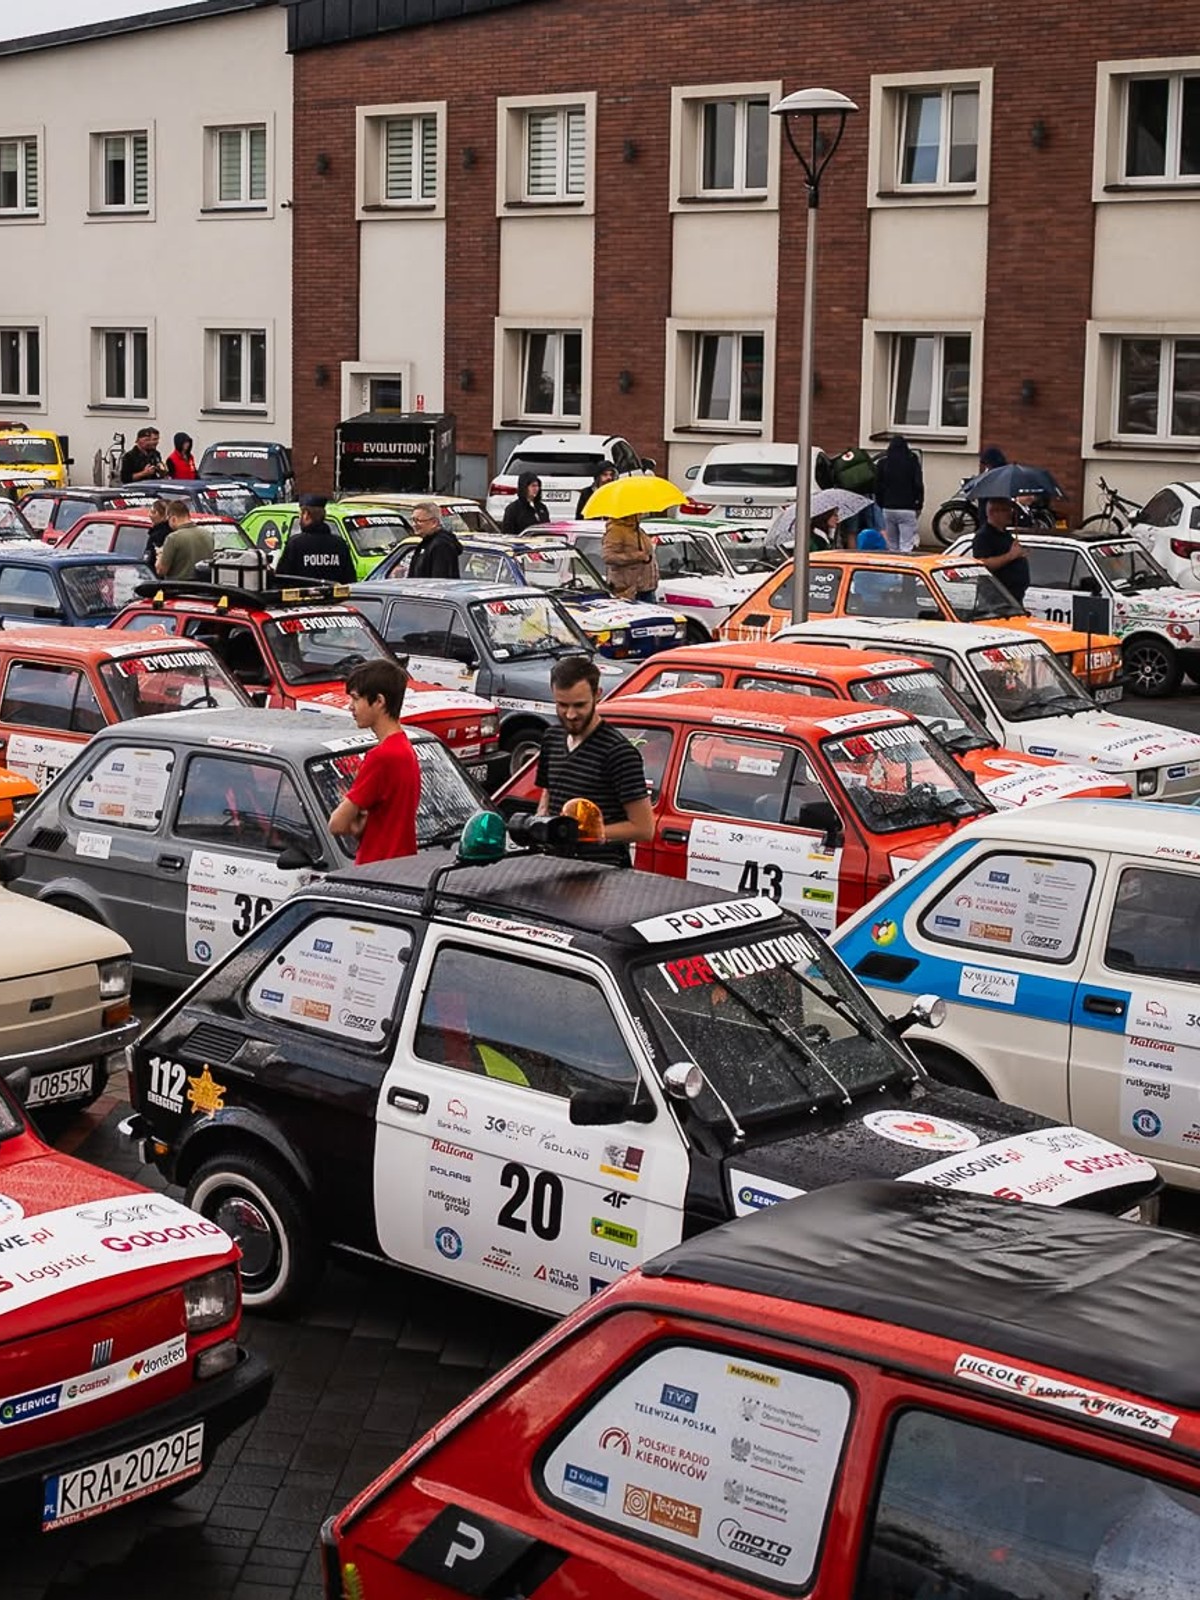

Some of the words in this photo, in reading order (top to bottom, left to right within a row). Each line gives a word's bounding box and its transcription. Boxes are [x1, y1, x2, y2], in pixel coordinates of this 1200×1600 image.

[303, 554, 340, 566] POLICJA
[738, 860, 784, 906] 43
[666, 902, 763, 935] POLAND
[657, 932, 821, 994] [126EVOLUTION]
[1129, 1035, 1175, 1053] Baltona
[38, 1067, 91, 1098] 0855K
[148, 1056, 187, 1100] 112
[1125, 1077, 1171, 1093] rutkowski
[1143, 1087, 1170, 1100] group
[431, 1138, 475, 1162] Baltona
[544, 1142, 590, 1161] SOLAND
[430, 1165, 472, 1184] POLARIS
[428, 1189, 472, 1208] rutkowski
[444, 1202, 471, 1217] group
[497, 1161, 565, 1242] 20
[602, 1190, 633, 1210] 4F
[99, 1221, 223, 1254] Gabona
[14, 1252, 96, 1284] Logistic
[549, 1267, 579, 1283] ATLAS
[549, 1275, 580, 1292] WARD
[142, 1345, 186, 1375] donateo
[78, 1375, 112, 1396] Castrol
[666, 1389, 693, 1406] TVP
[15, 1393, 58, 1415] SERVICE
[634, 1402, 679, 1424] TELEWIZJA
[682, 1416, 717, 1435] POLSKA
[637, 1435, 677, 1458] POLSKIE
[678, 1448, 711, 1468] RADIO
[61, 1463, 114, 1515] KRA
[122, 1430, 201, 1492] 2029E
[635, 1450, 708, 1482] KIEROWCÓW
[43, 1504, 56, 1516] PL
[652, 1494, 698, 1524] Jedynka
[734, 1528, 793, 1557] MOTO
